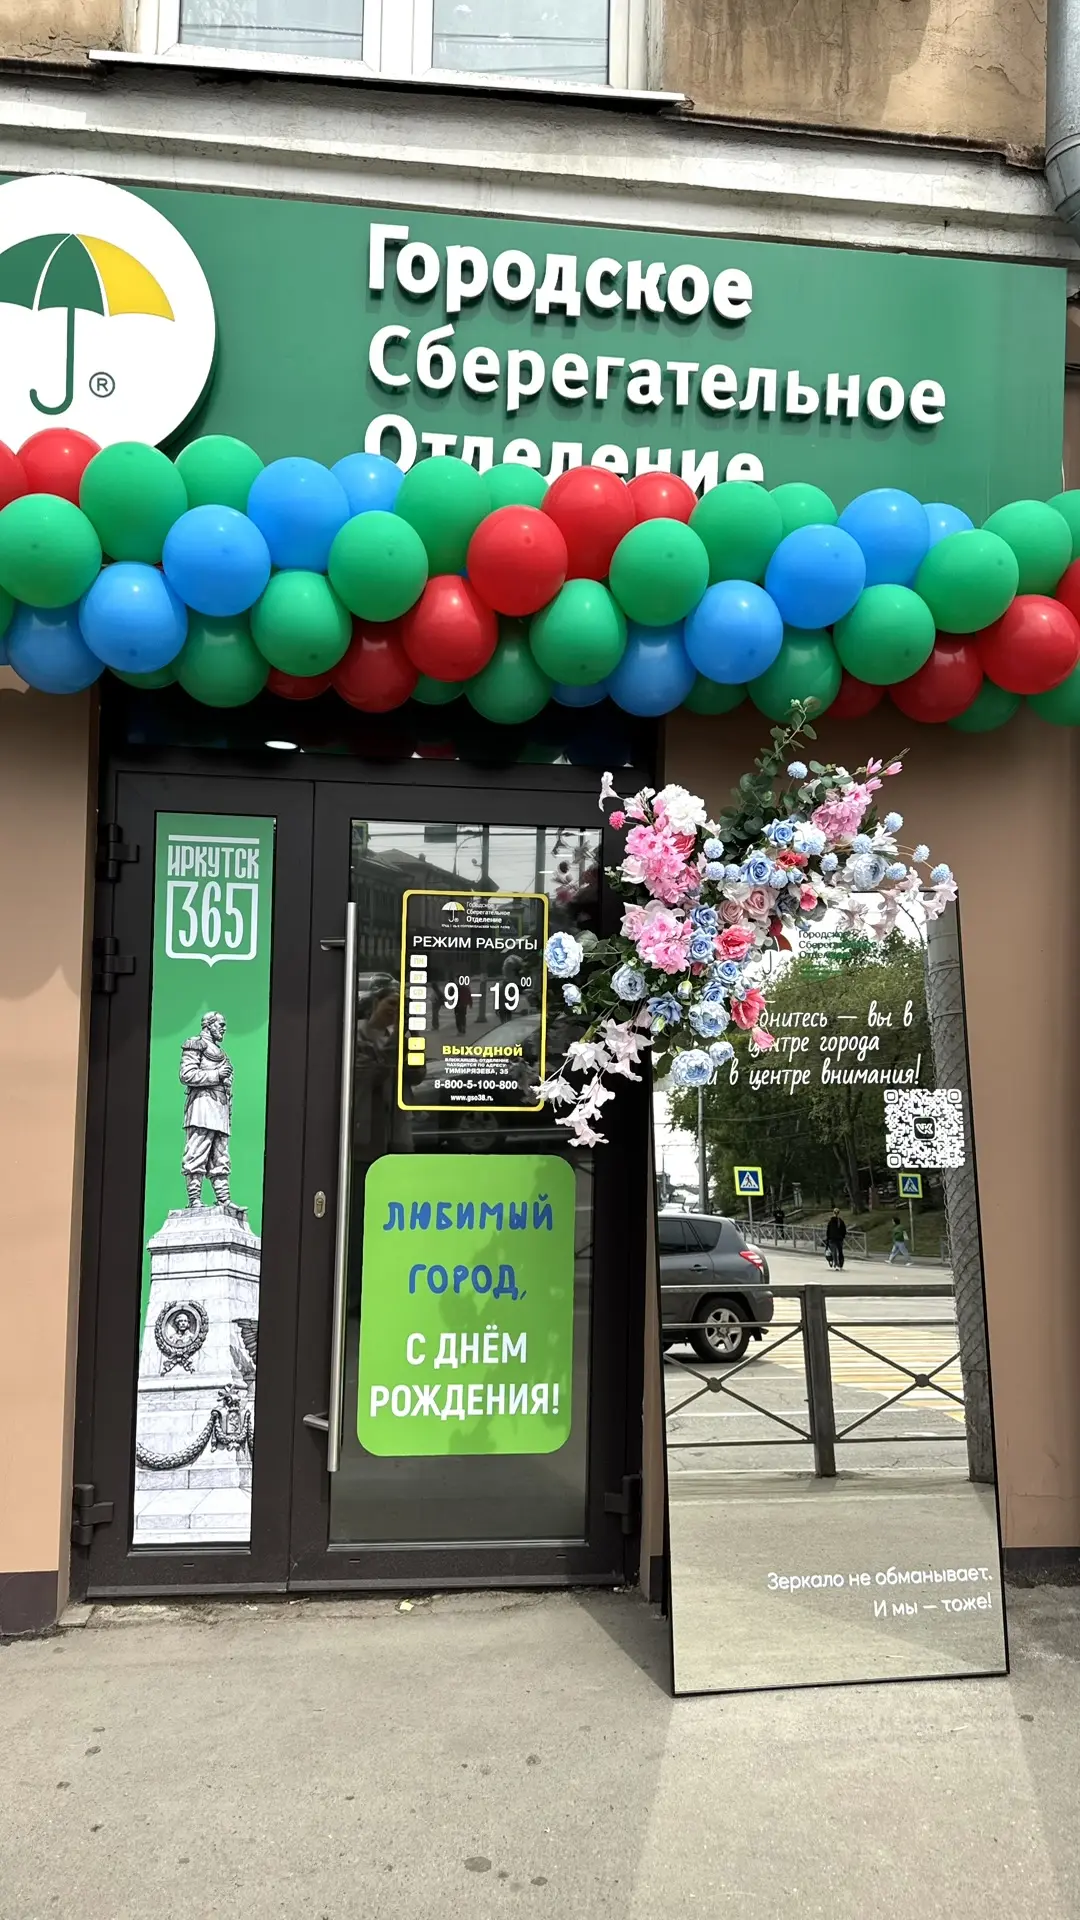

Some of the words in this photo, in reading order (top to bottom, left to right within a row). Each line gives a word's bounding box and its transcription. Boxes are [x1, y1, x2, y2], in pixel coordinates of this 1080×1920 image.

[368, 222, 754, 322] Городское
[367, 323, 947, 425] Сберегательное
[167, 844, 260, 879] ИРКУТСК
[174, 881, 250, 948] 365
[466, 908, 511, 916] Сберегательное
[466, 915, 503, 923] Отделение
[413, 935, 471, 948] РЕЖИМ
[476, 937, 538, 950] РАБОТЫ
[868, 1000, 893, 1027] вы
[903, 1000, 913, 1027] в
[442, 1043, 523, 1058] ВЫХОДНОЙ
[820, 1035, 880, 1062] города
[434, 1079, 518, 1090] 8-800-5-100-800
[729, 1058, 739, 1085] в
[749, 1069, 810, 1095] центре
[821, 1053, 922, 1085] внимания!
[382, 1193, 554, 1231] ЛЮБИМЫЙ
[408, 1264, 527, 1301] ГОРОД,
[405, 1332, 426, 1365] С
[433, 1324, 527, 1369] ДНЁМ
[369, 1383, 559, 1421] РОЖДЕНИЯ!
[767, 1571, 845, 1593] Зеркало
[849, 1572, 871, 1586] не
[875, 1566, 993, 1586] обманывает.
[873, 1600, 888, 1617] И
[892, 1601, 918, 1616] мы
[941, 1592, 993, 1613] тоже!
